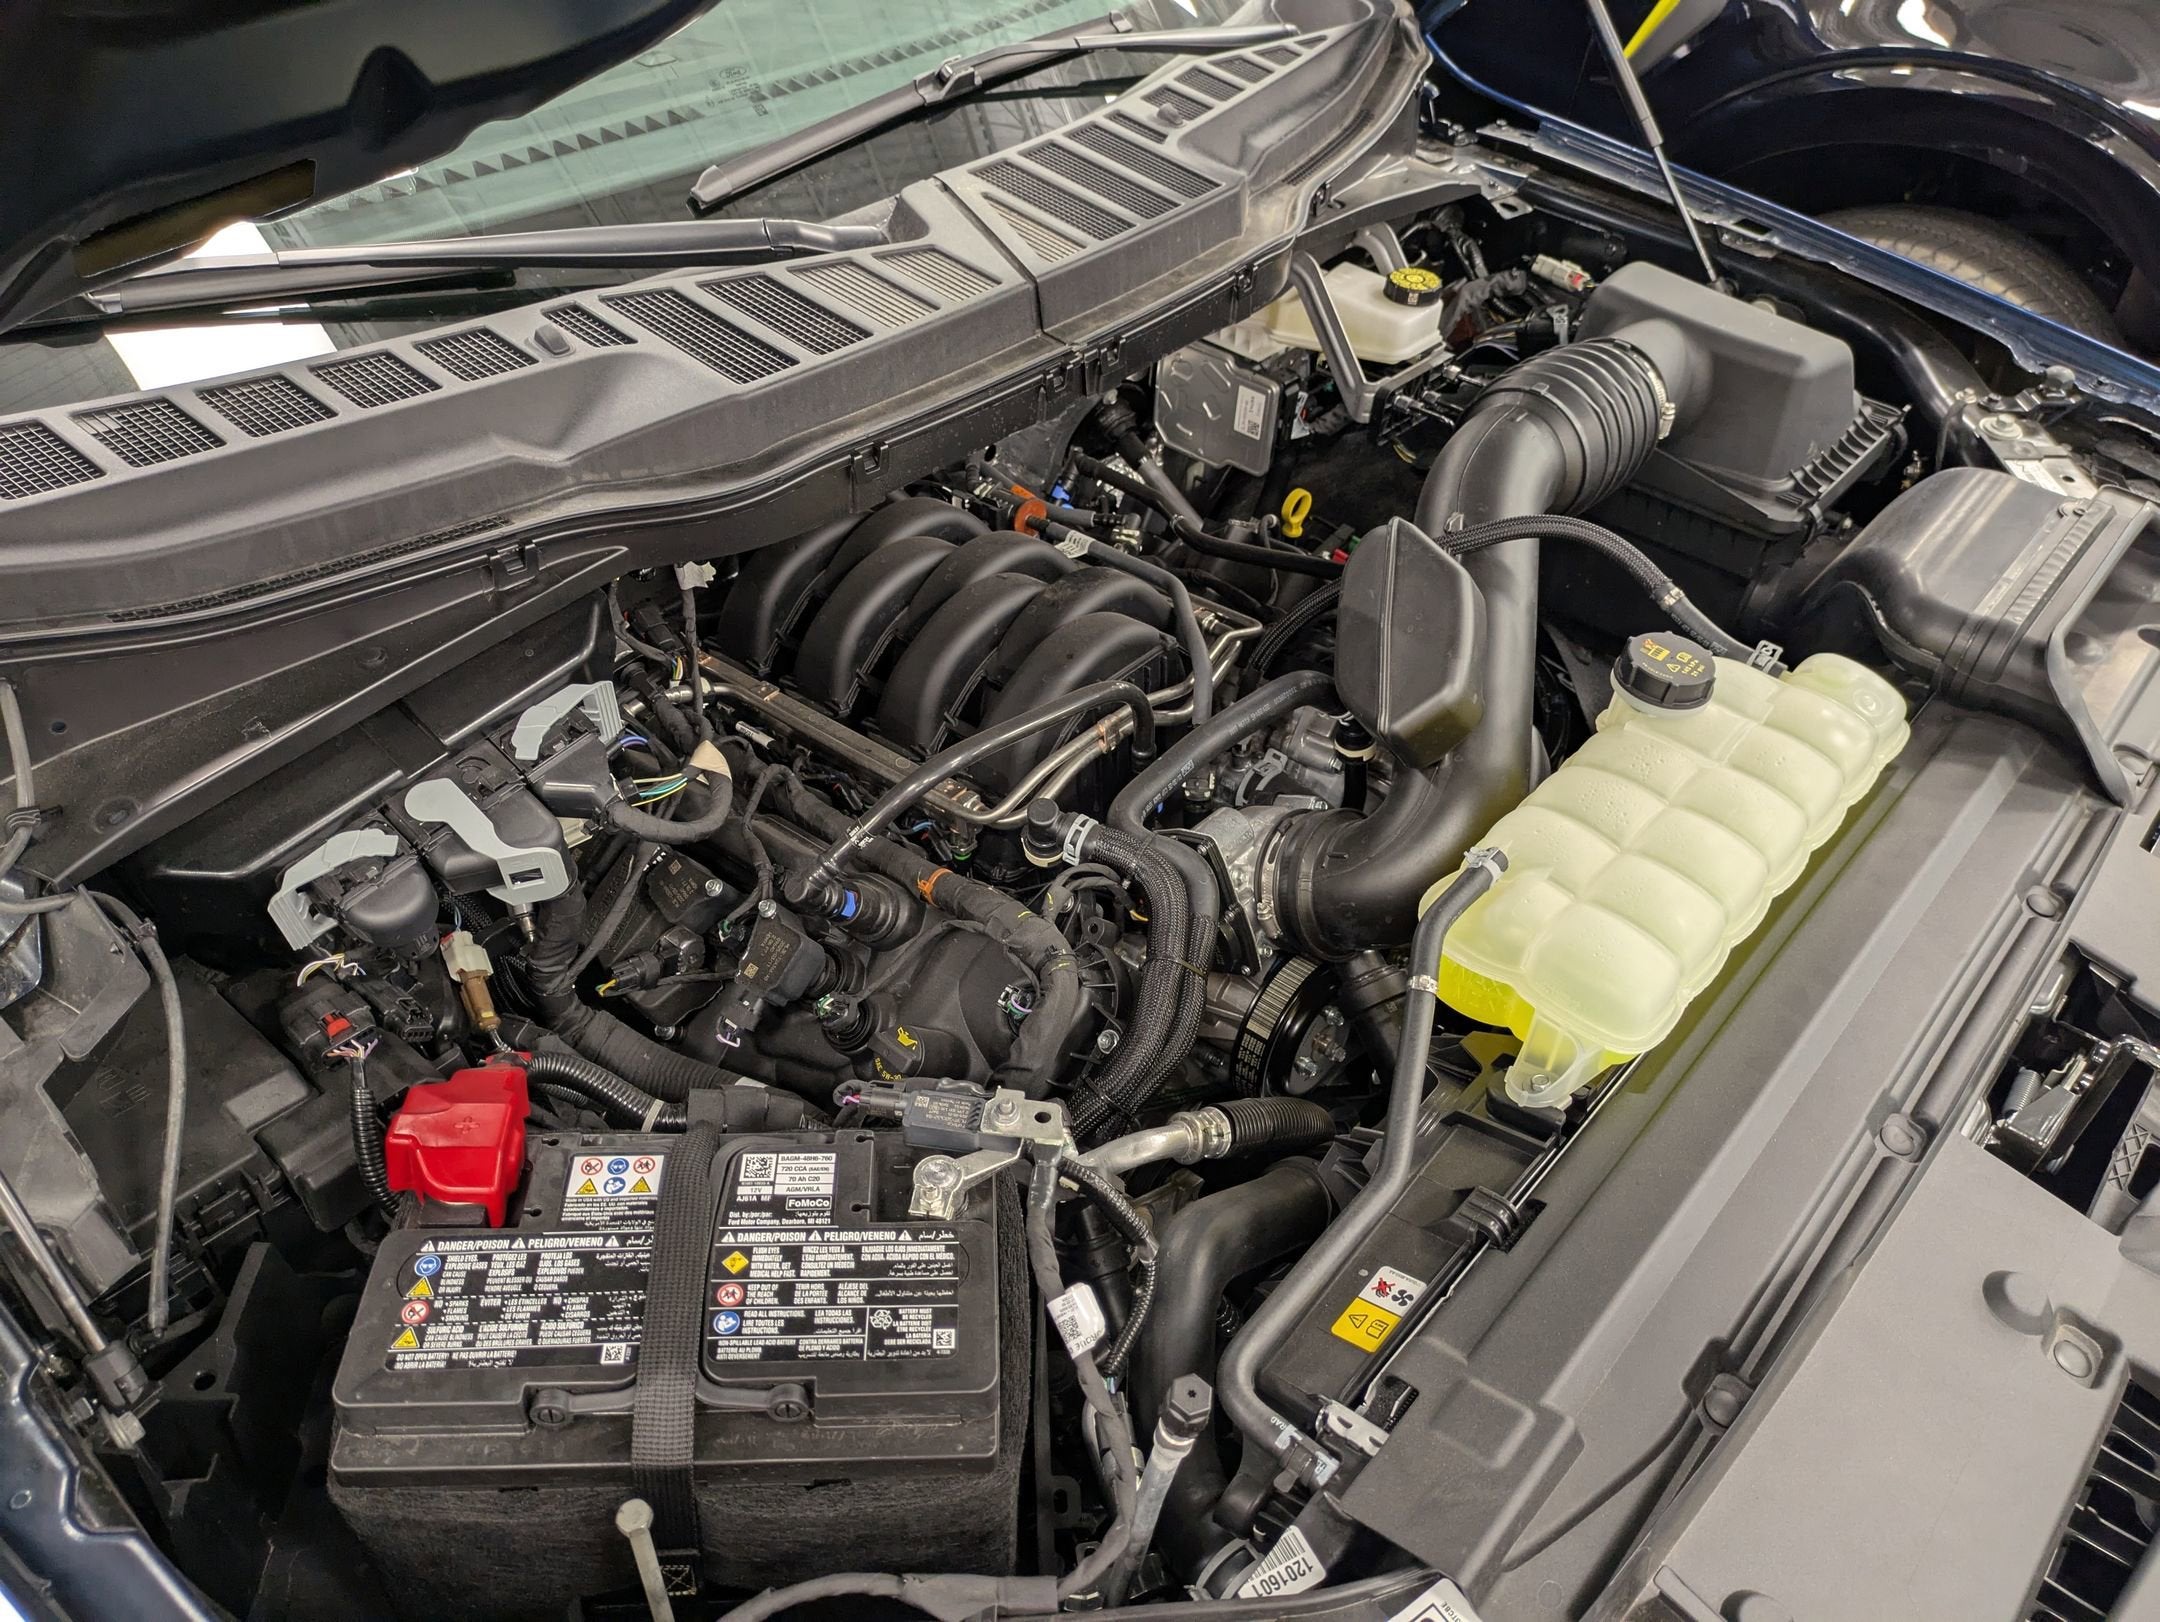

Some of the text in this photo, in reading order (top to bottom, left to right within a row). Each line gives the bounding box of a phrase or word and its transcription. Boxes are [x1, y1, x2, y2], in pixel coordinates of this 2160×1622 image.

[788, 1198, 830, 1208] FoMoCo
[737, 1231, 806, 1242] DANGER/POISON
[823, 1230, 896, 1242] PELIGRO/VENENO
[437, 1239, 510, 1251] DANGER/POISON
[528, 1237, 604, 1249] PELIGRO/VENENO
[929, 1252, 935, 1260] EL
[749, 1270, 770, 1278] MEDICAL
[770, 1270, 782, 1278] HELP
[747, 1283, 760, 1291] KEEP
[760, 1283, 772, 1291] OUT
[860, 1282, 868, 1290] DEL
[747, 1290, 774, 1298] THE REACH
[794, 1290, 802, 1298] DE
[802, 1290, 810, 1298] LA
[449, 1299, 469, 1307] SPARKS
[508, 1298, 516, 1306] LES
[567, 1296, 590, 1304] CHISPAS
[753, 1297, 780, 1305] CHILDREN.
[566, 1303, 586, 1311] FLAMAS
[445, 1314, 470, 1322] SMOKING
[504, 1312, 531, 1320] DE FUMER
[743, 1310, 758, 1318] READ
[758, 1310, 768, 1318] ALL
[742, 1319, 755, 1327] LIRE
[755, 1319, 774, 1327] TOUTES
[451, 1325, 464, 1334] ACID
[1270, 1415, 1287, 1430] RAD
[1252, 1557, 1313, 1598] 1201601
